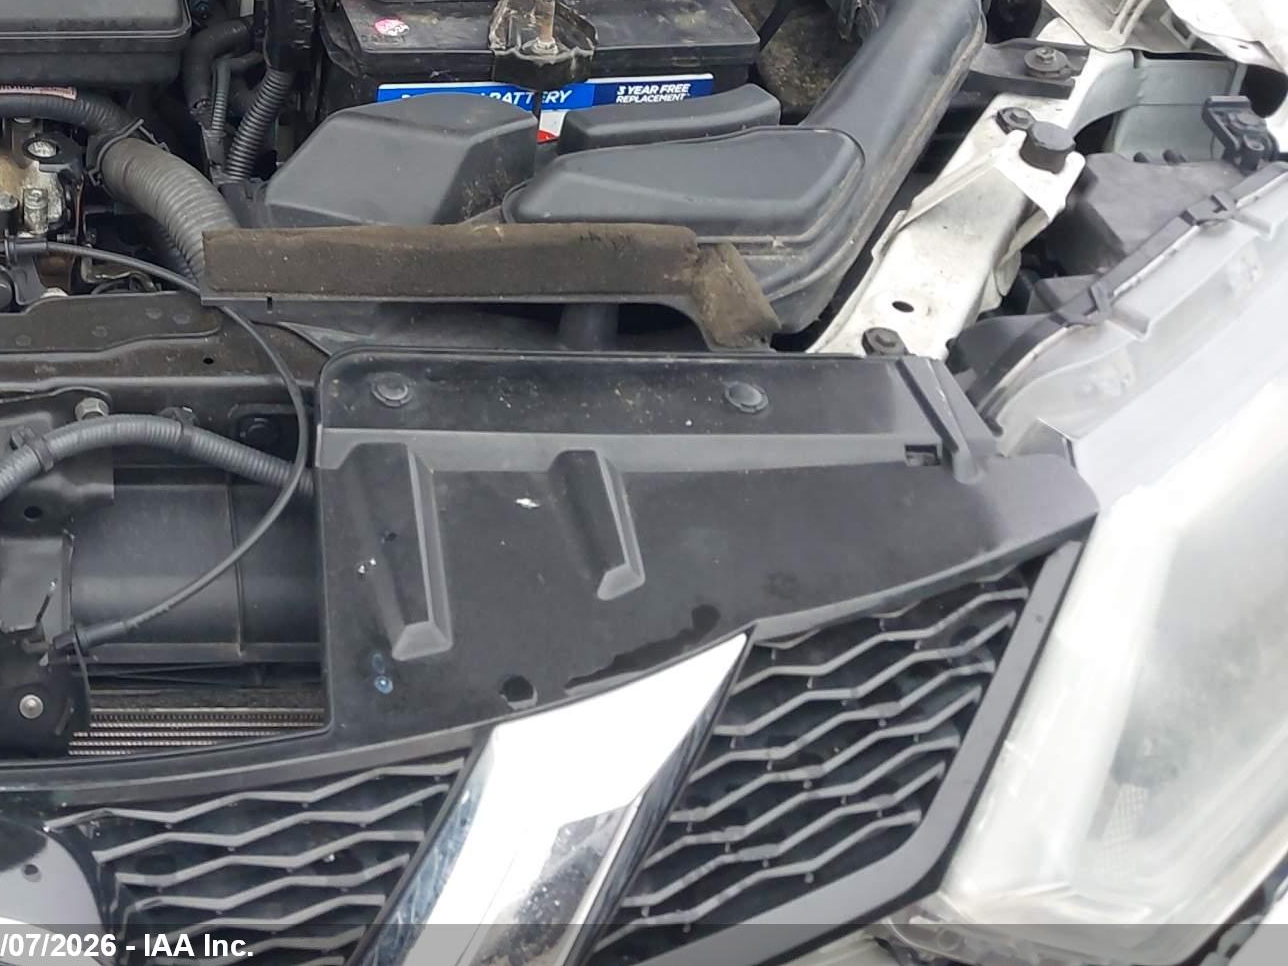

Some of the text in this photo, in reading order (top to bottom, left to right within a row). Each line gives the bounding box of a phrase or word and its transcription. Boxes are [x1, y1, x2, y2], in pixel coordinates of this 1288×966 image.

[616, 83, 691, 96] 3 YEAR FREE
